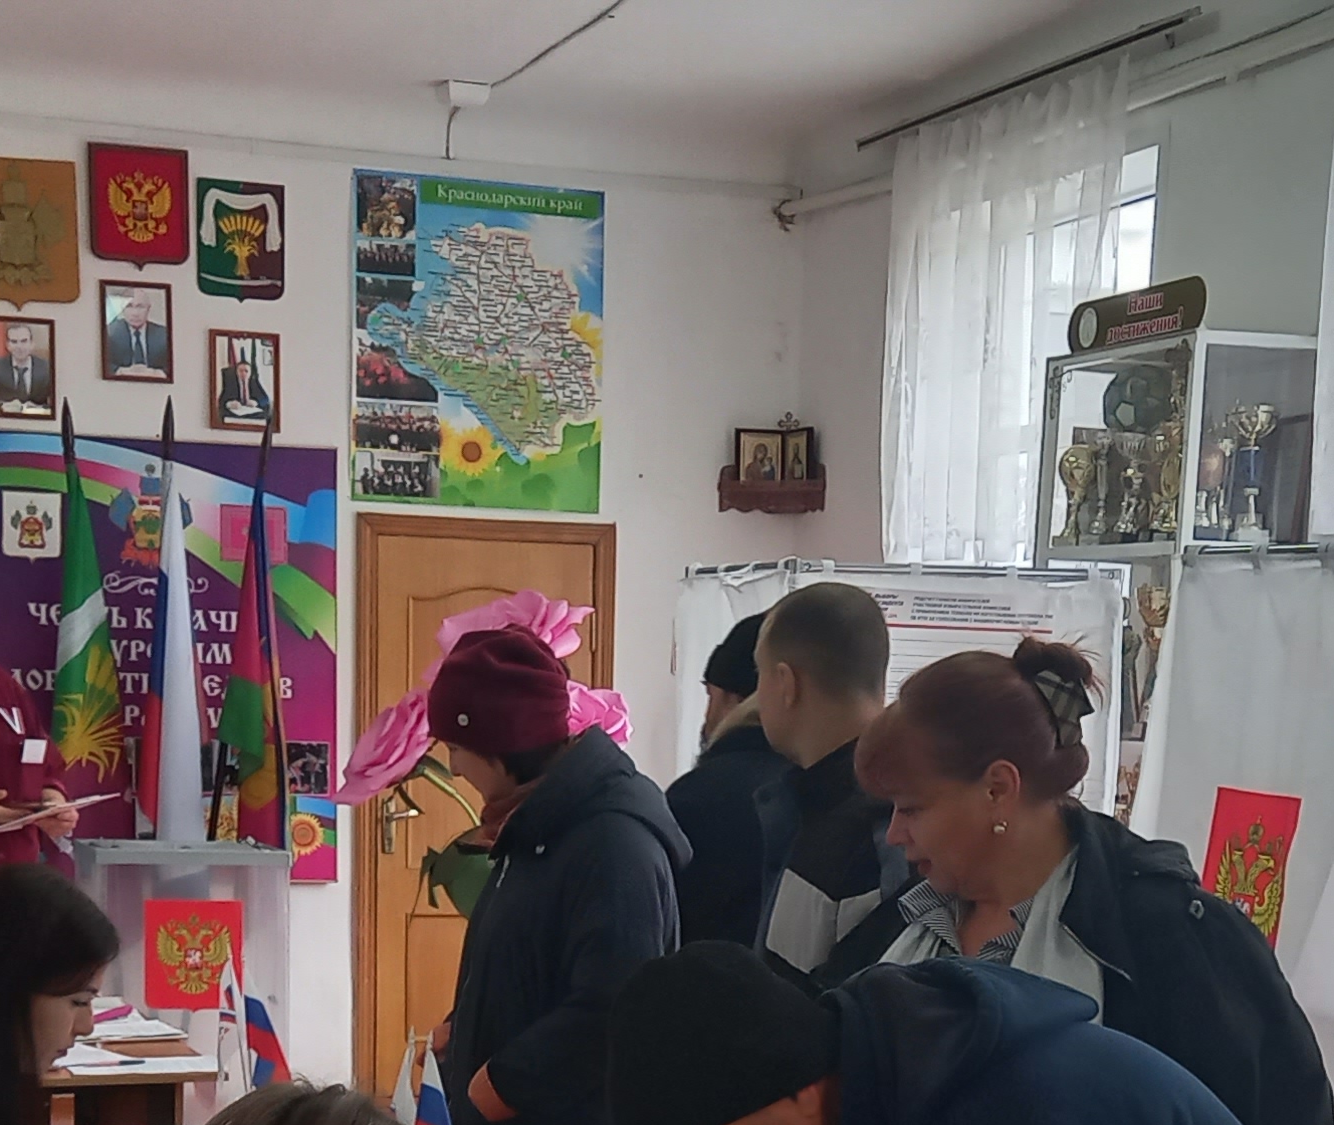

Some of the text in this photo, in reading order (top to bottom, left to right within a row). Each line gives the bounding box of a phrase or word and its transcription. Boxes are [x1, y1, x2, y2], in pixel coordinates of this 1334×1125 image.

[436, 183, 584, 214] Краснодарский край
[1127, 287, 1164, 315] Наши
[1106, 306, 1184, 345] достижения!
